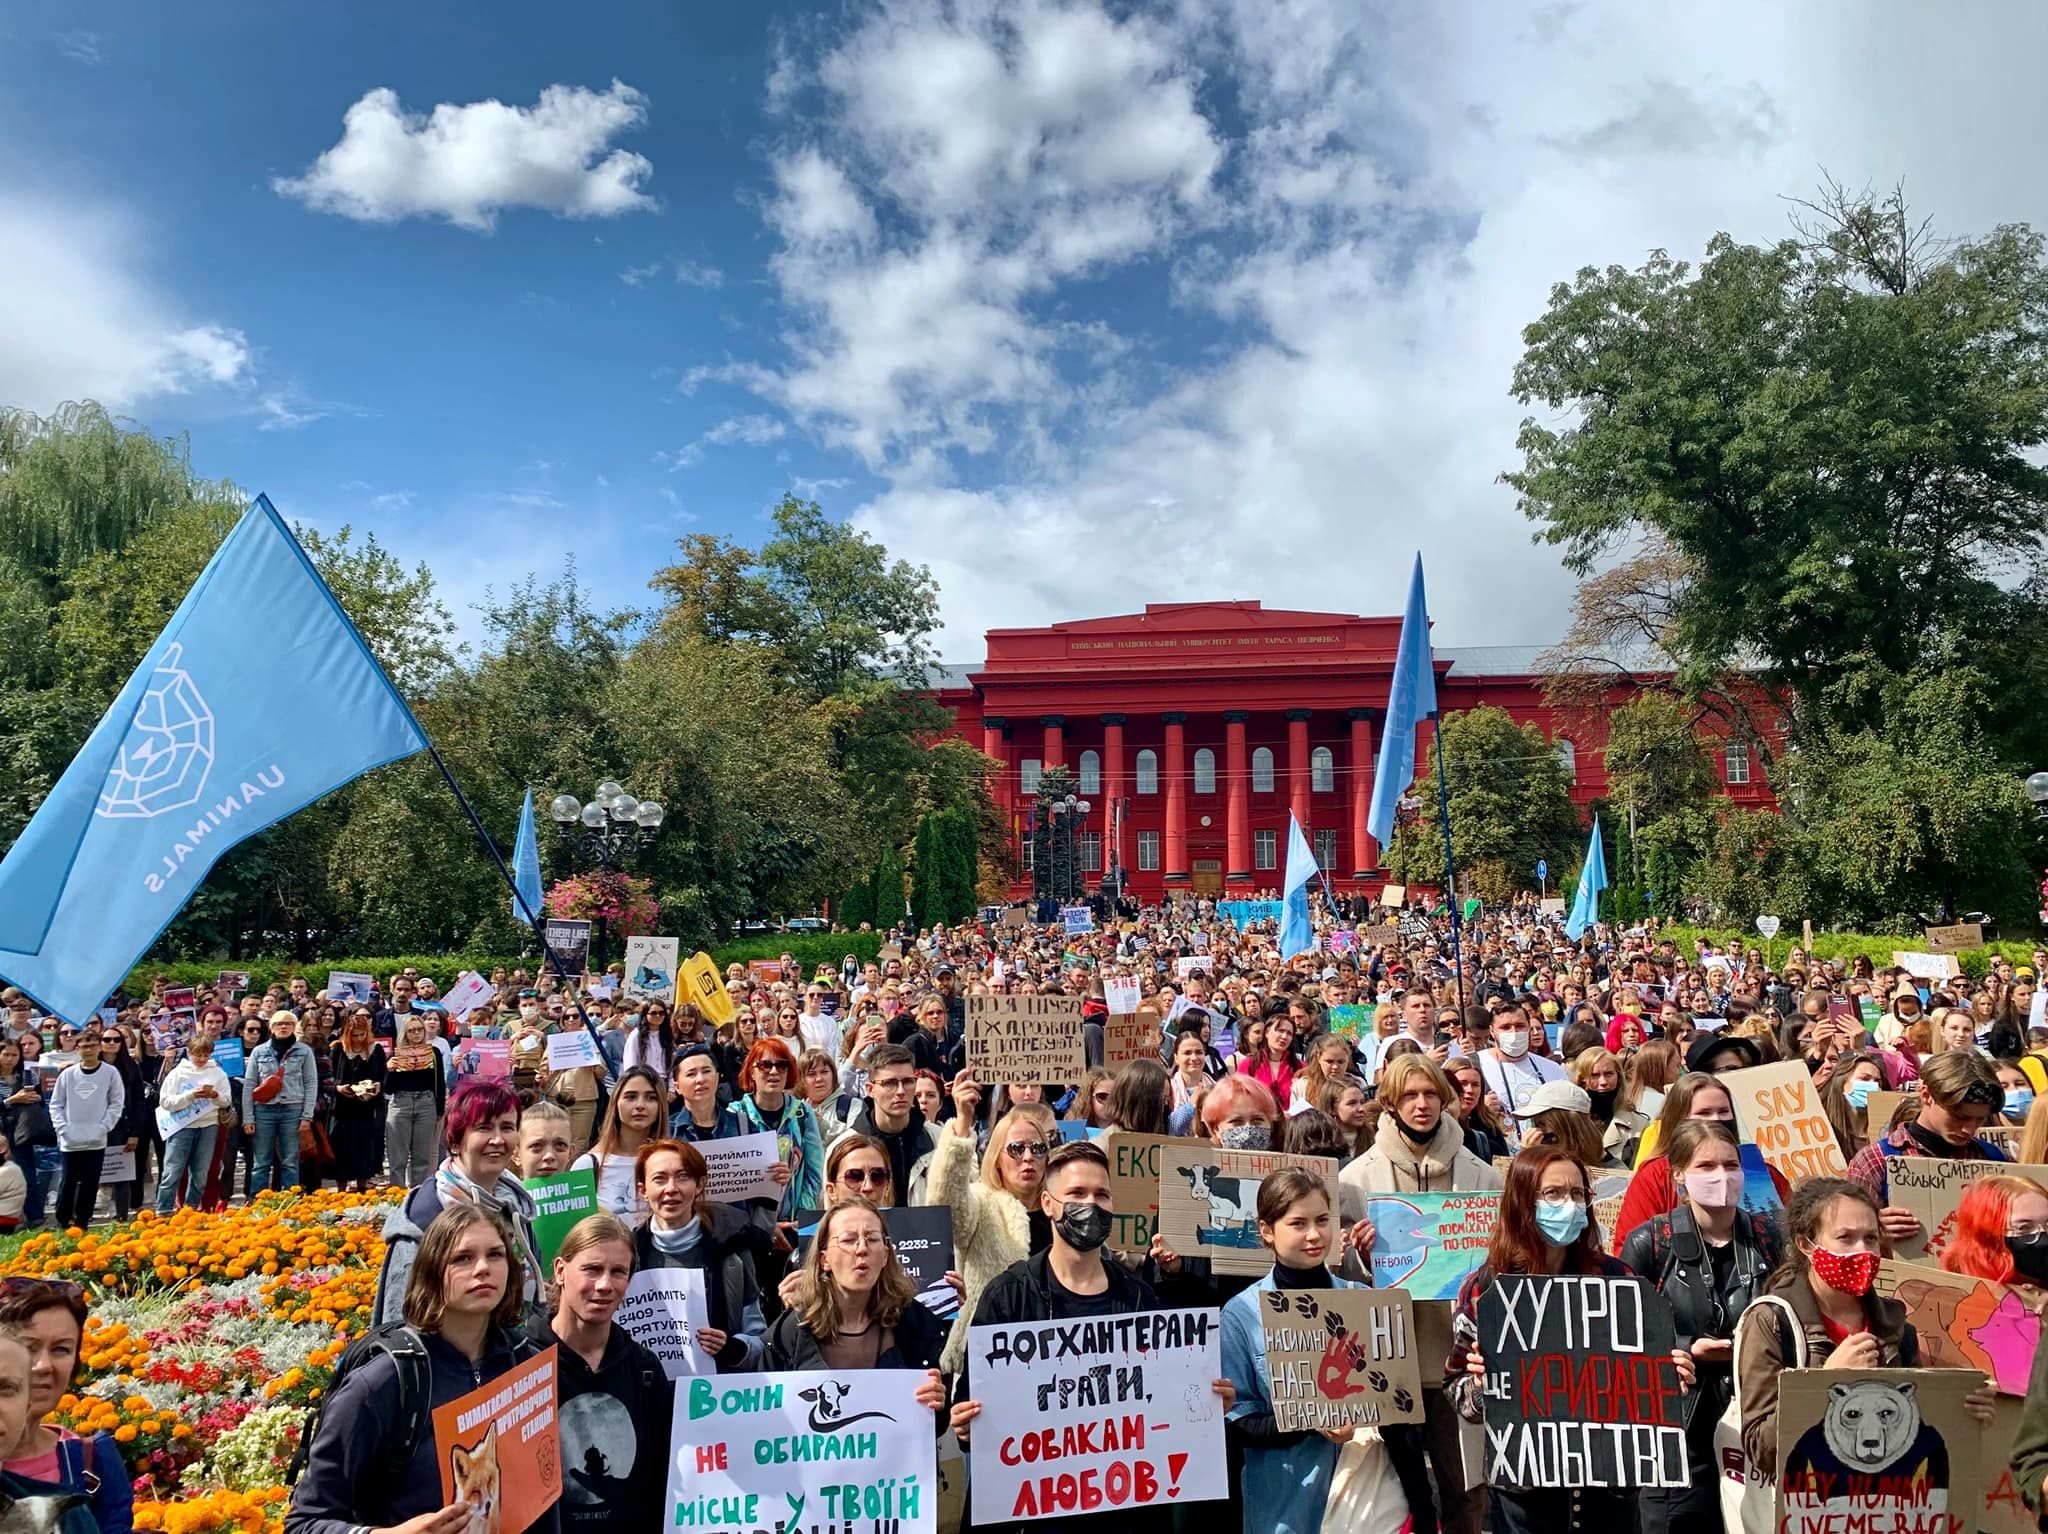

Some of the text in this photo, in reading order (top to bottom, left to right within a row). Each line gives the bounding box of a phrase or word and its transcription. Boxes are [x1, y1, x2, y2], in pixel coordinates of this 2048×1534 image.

[1263, 636, 1294, 645] ТАРАСА
[547, 926, 590, 939] THEIR LIFE
[556, 939, 578, 949] HELL
[969, 997, 1018, 1015] МОЯ
[969, 1039, 989, 1054] НЕ
[1755, 1080, 1806, 1121] SAY
[1756, 1115, 1830, 1151] NO TO
[1989, 1131, 2009, 1149] НЕ
[704, 1149, 763, 1161] ПРИЙМІТЬ
[1766, 1144, 1848, 1181] ASTIC
[1889, 1156, 1911, 1174] ЗА
[1894, 1171, 1946, 1190] СКІЛЬКИ
[705, 1187, 748, 1195] ТВАРИН
[542, 1195, 590, 1215] ТВАРИН!
[1441, 1195, 1504, 1211] ДОЗВОЛЬТ
[898, 1239, 929, 1251] 2232
[1375, 1255, 1414, 1268] НЕВОЛЯ
[619, 1307, 654, 1325] 5409
[1494, 1278, 1644, 1353] ХУТРО
[1264, 1327, 1328, 1352] НАСИЛЛЮ
[513, 1361, 553, 1400] ЗАБОРОНИ
[1269, 1360, 1318, 1399] НАД
[1482, 1353, 1680, 1427] ЦЕ КРИВАВЕ
[1273, 1400, 1381, 1431] ТВАРИНАМИ
[695, 1432, 877, 1474] НЕ ОБИРАЛИ
[1484, 1422, 1692, 1488] ЖЛОБСТВО
[1783, 1471, 1838, 1509] HEY
[675, 1474, 920, 1534] МІСЦЕ У ТВОЇЙ
